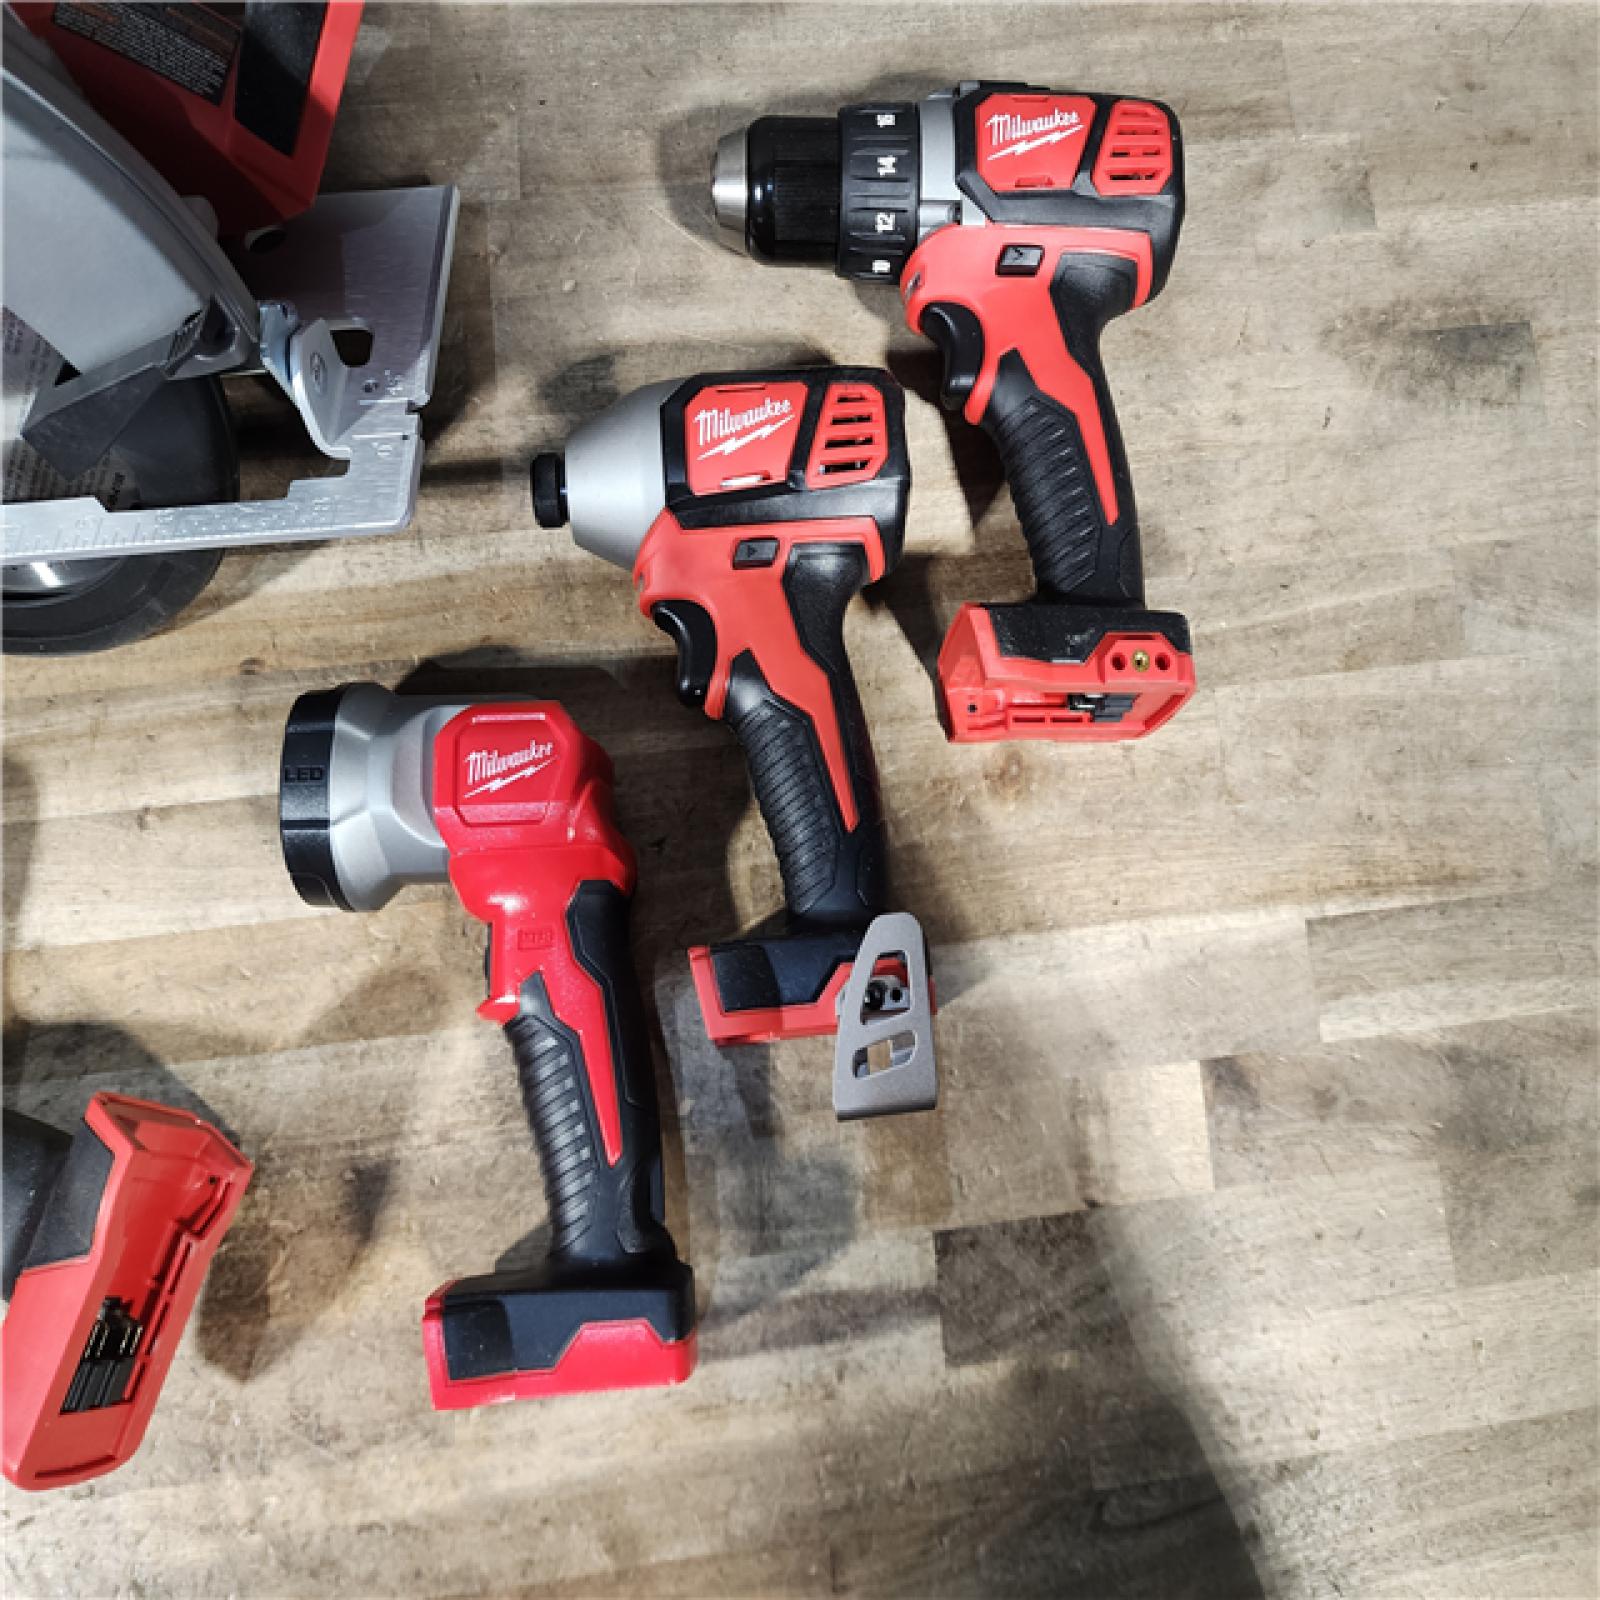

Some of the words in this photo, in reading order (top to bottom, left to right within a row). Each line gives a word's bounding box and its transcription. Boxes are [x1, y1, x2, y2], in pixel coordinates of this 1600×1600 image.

[985, 107, 1081, 146] Milwaukee
[876, 156, 898, 176] 14
[875, 212, 896, 233] 12
[693, 397, 793, 447] Milwaukee
[464, 740, 553, 785] Milwaukee
